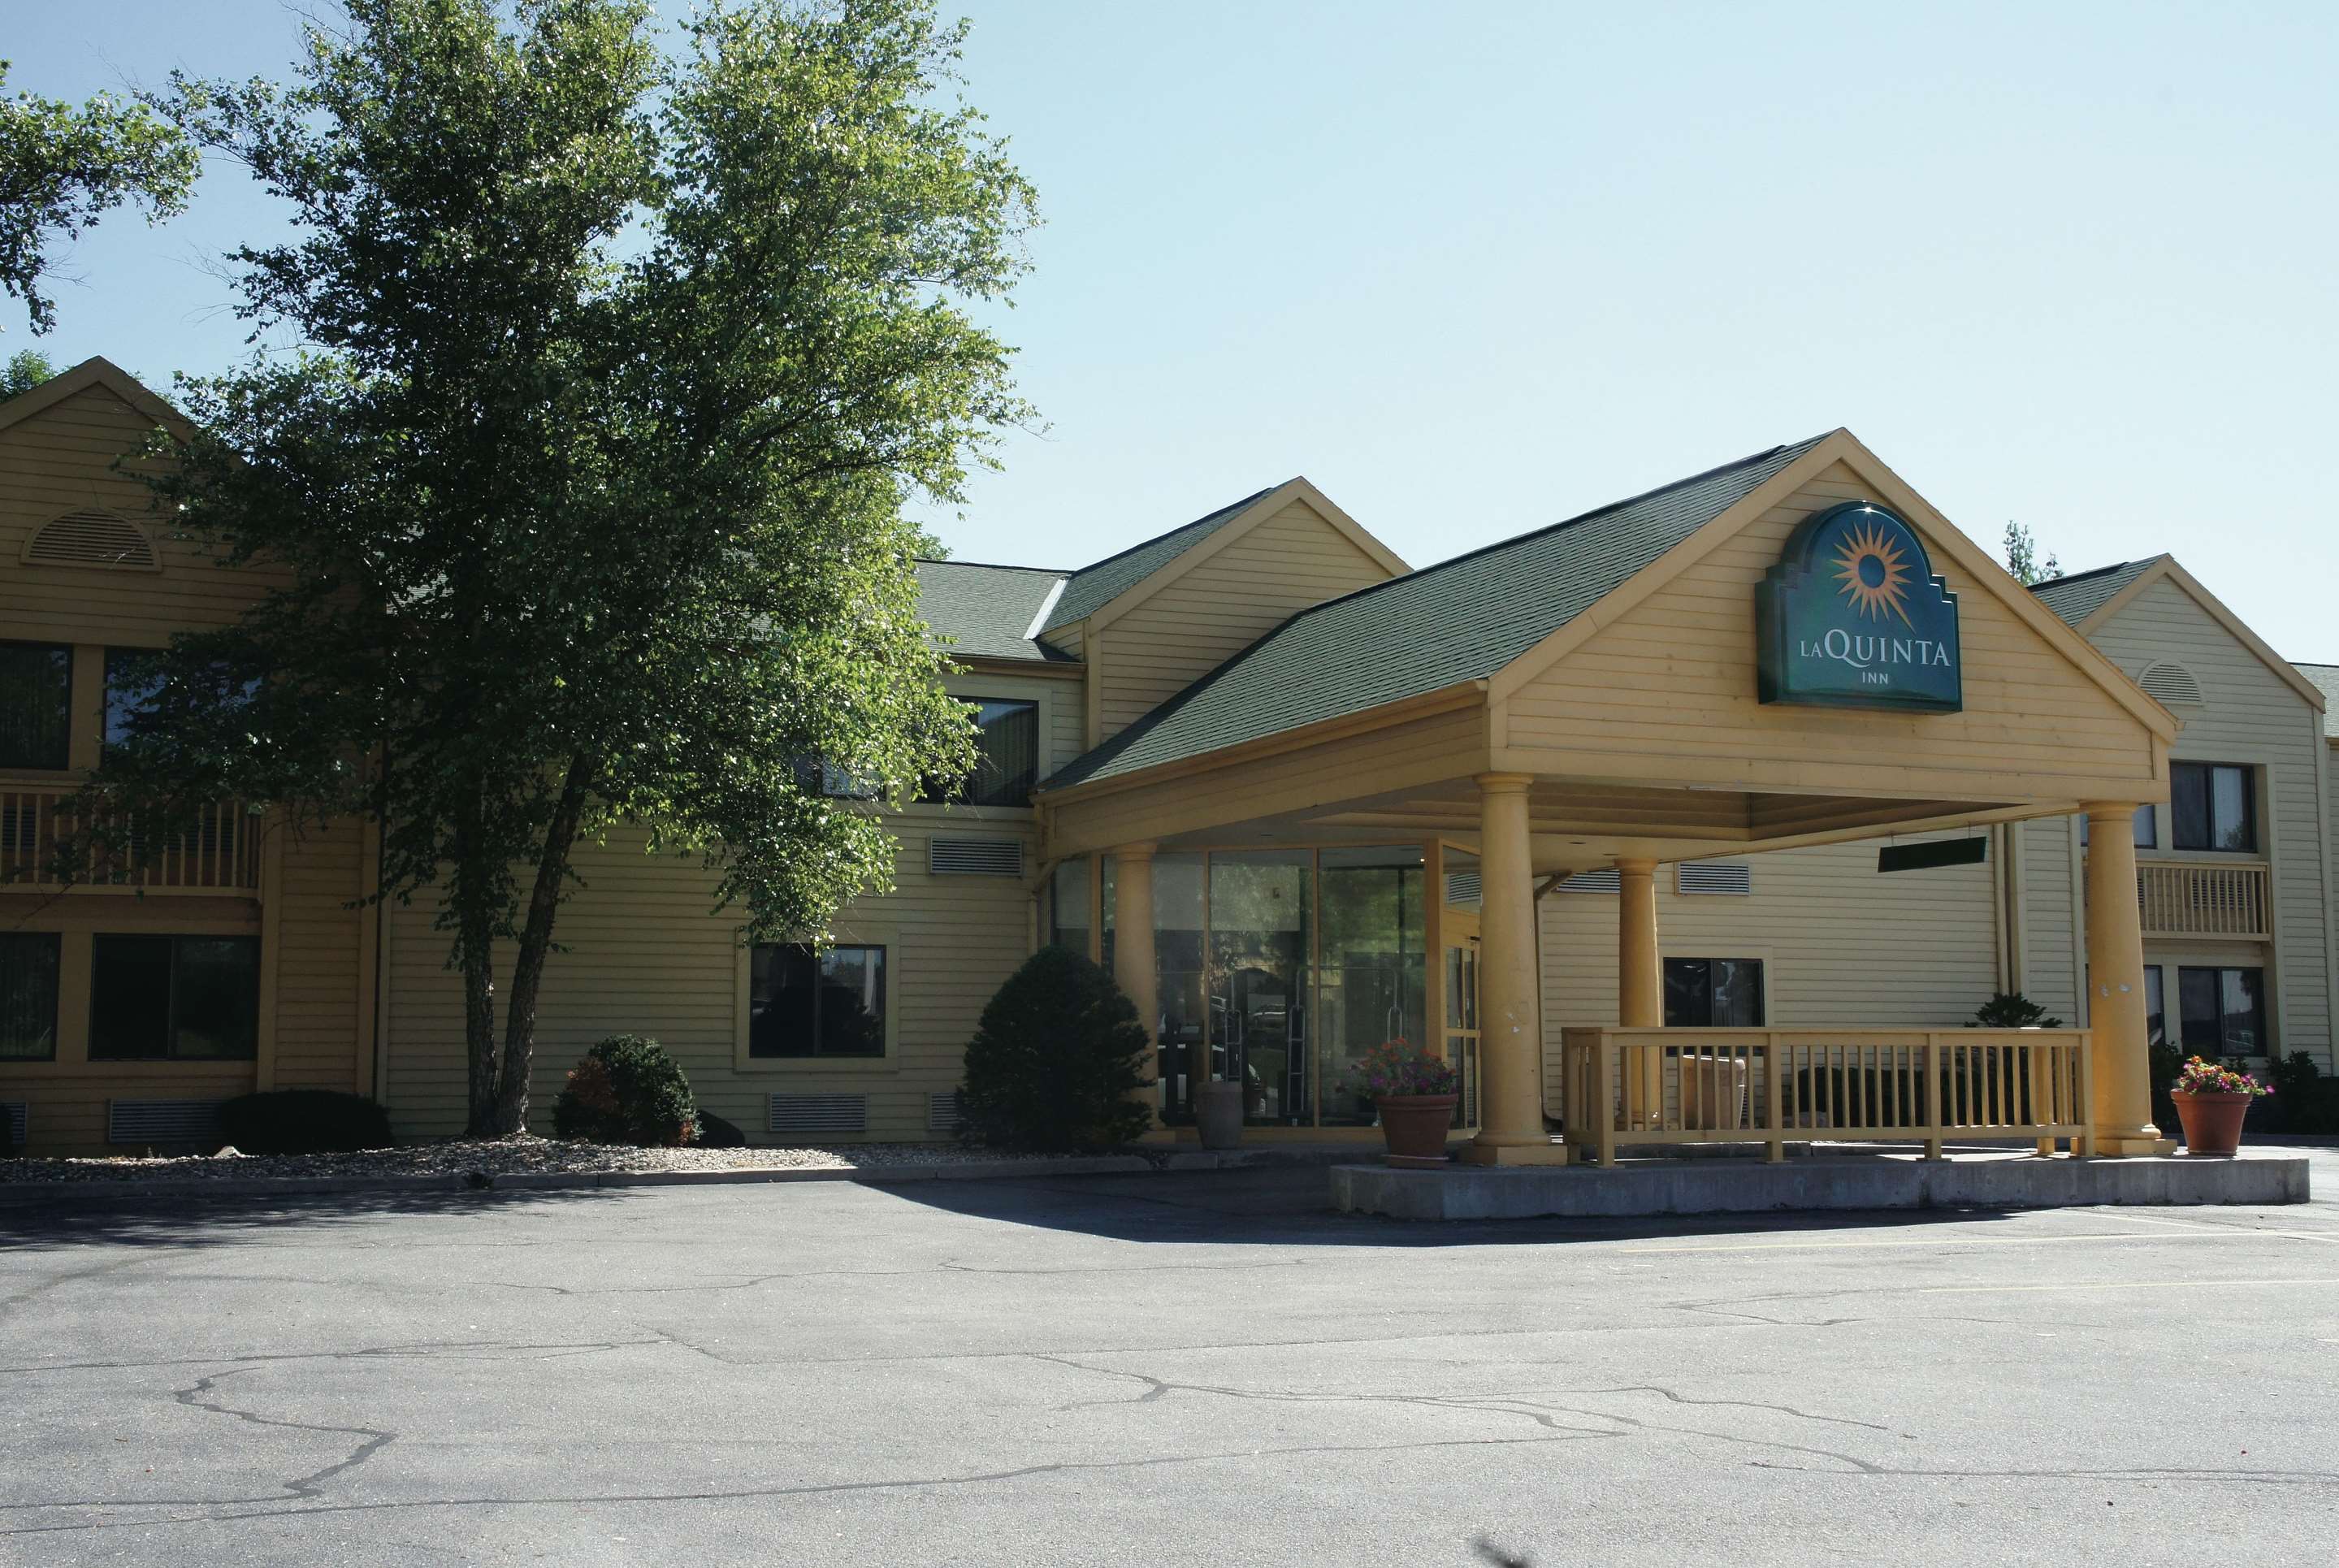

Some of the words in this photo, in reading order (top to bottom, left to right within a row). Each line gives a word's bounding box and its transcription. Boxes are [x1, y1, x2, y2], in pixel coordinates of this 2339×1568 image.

[1800, 641, 1823, 658] LA
[1824, 629, 1951, 668] QUINTA
[1862, 671, 1889, 685] INN
